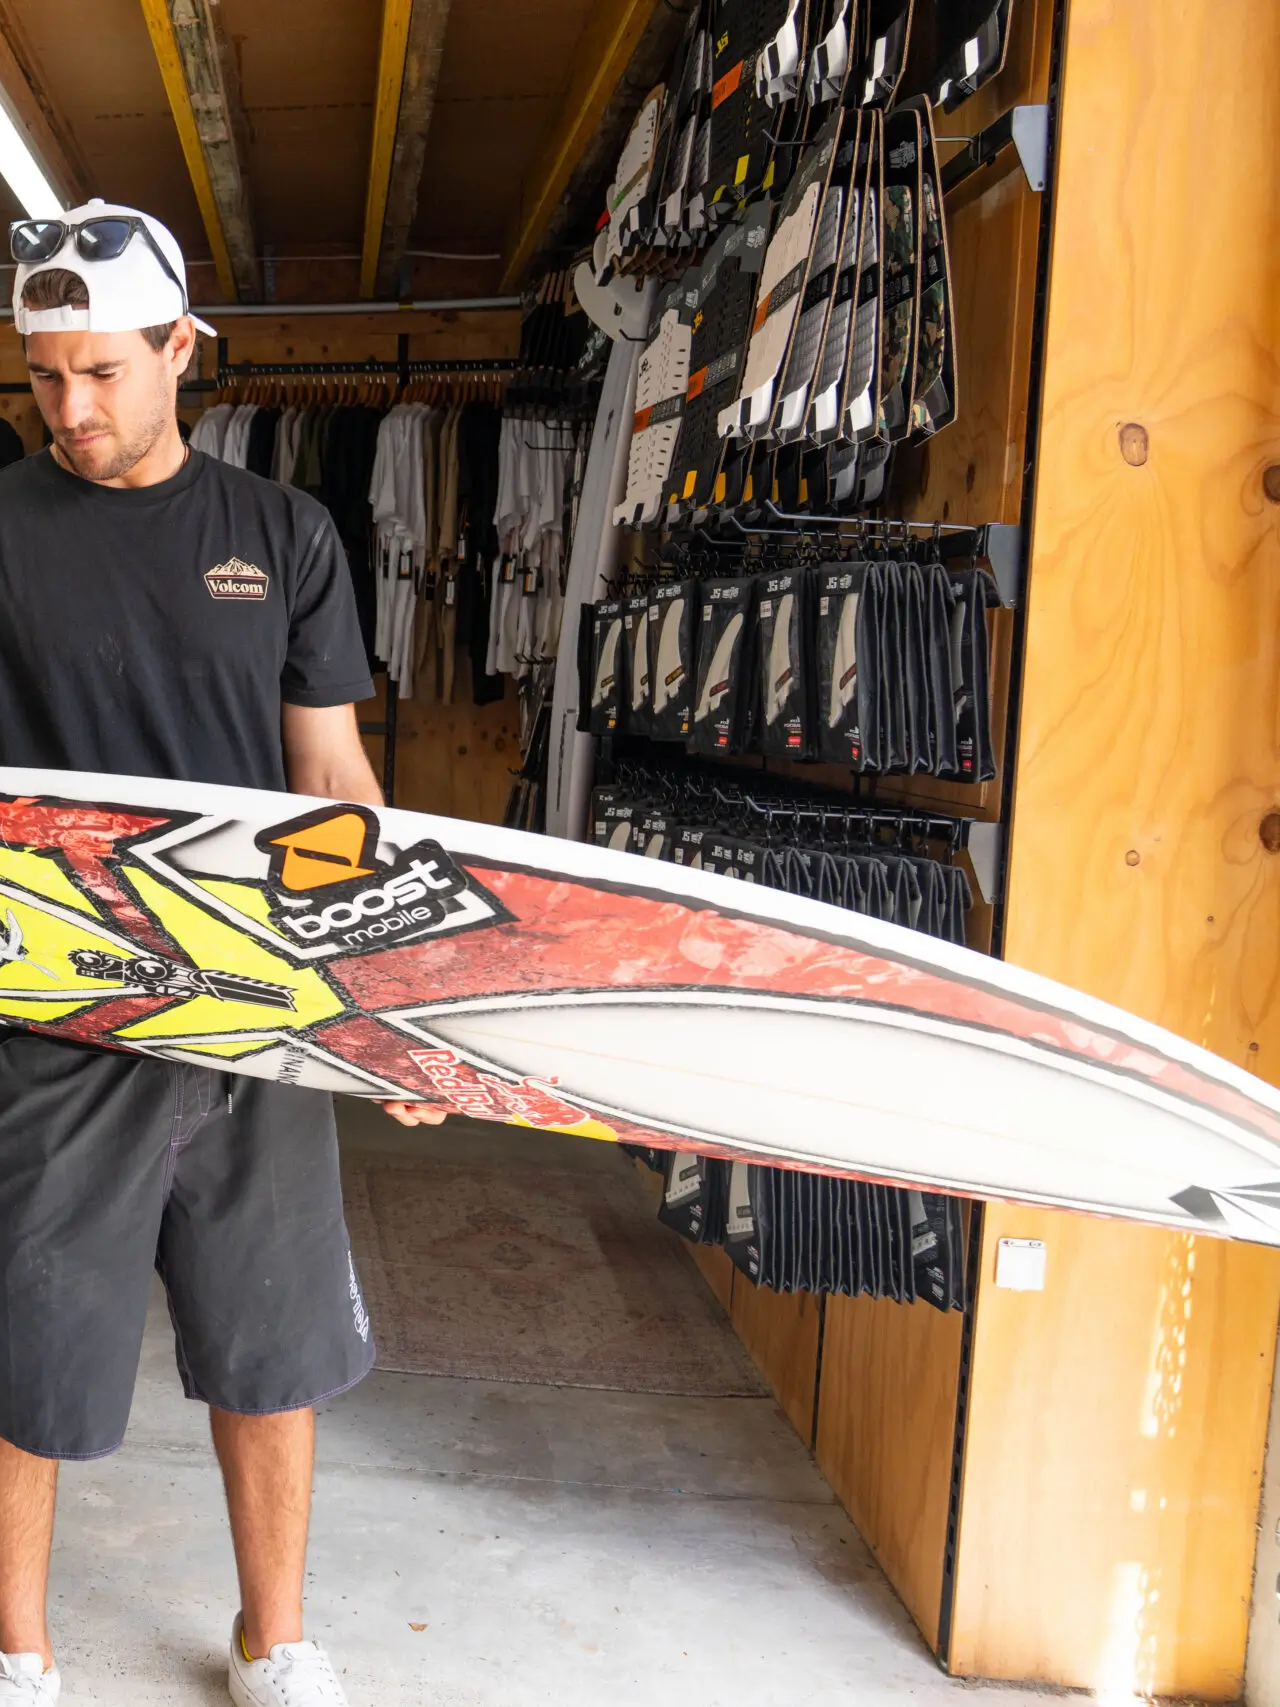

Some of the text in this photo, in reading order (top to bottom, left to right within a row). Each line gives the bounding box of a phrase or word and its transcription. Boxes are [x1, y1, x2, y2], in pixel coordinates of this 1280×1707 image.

[207, 579, 264, 594] Volcom
[281, 859, 452, 939] boost
[342, 906, 432, 946] mobile
